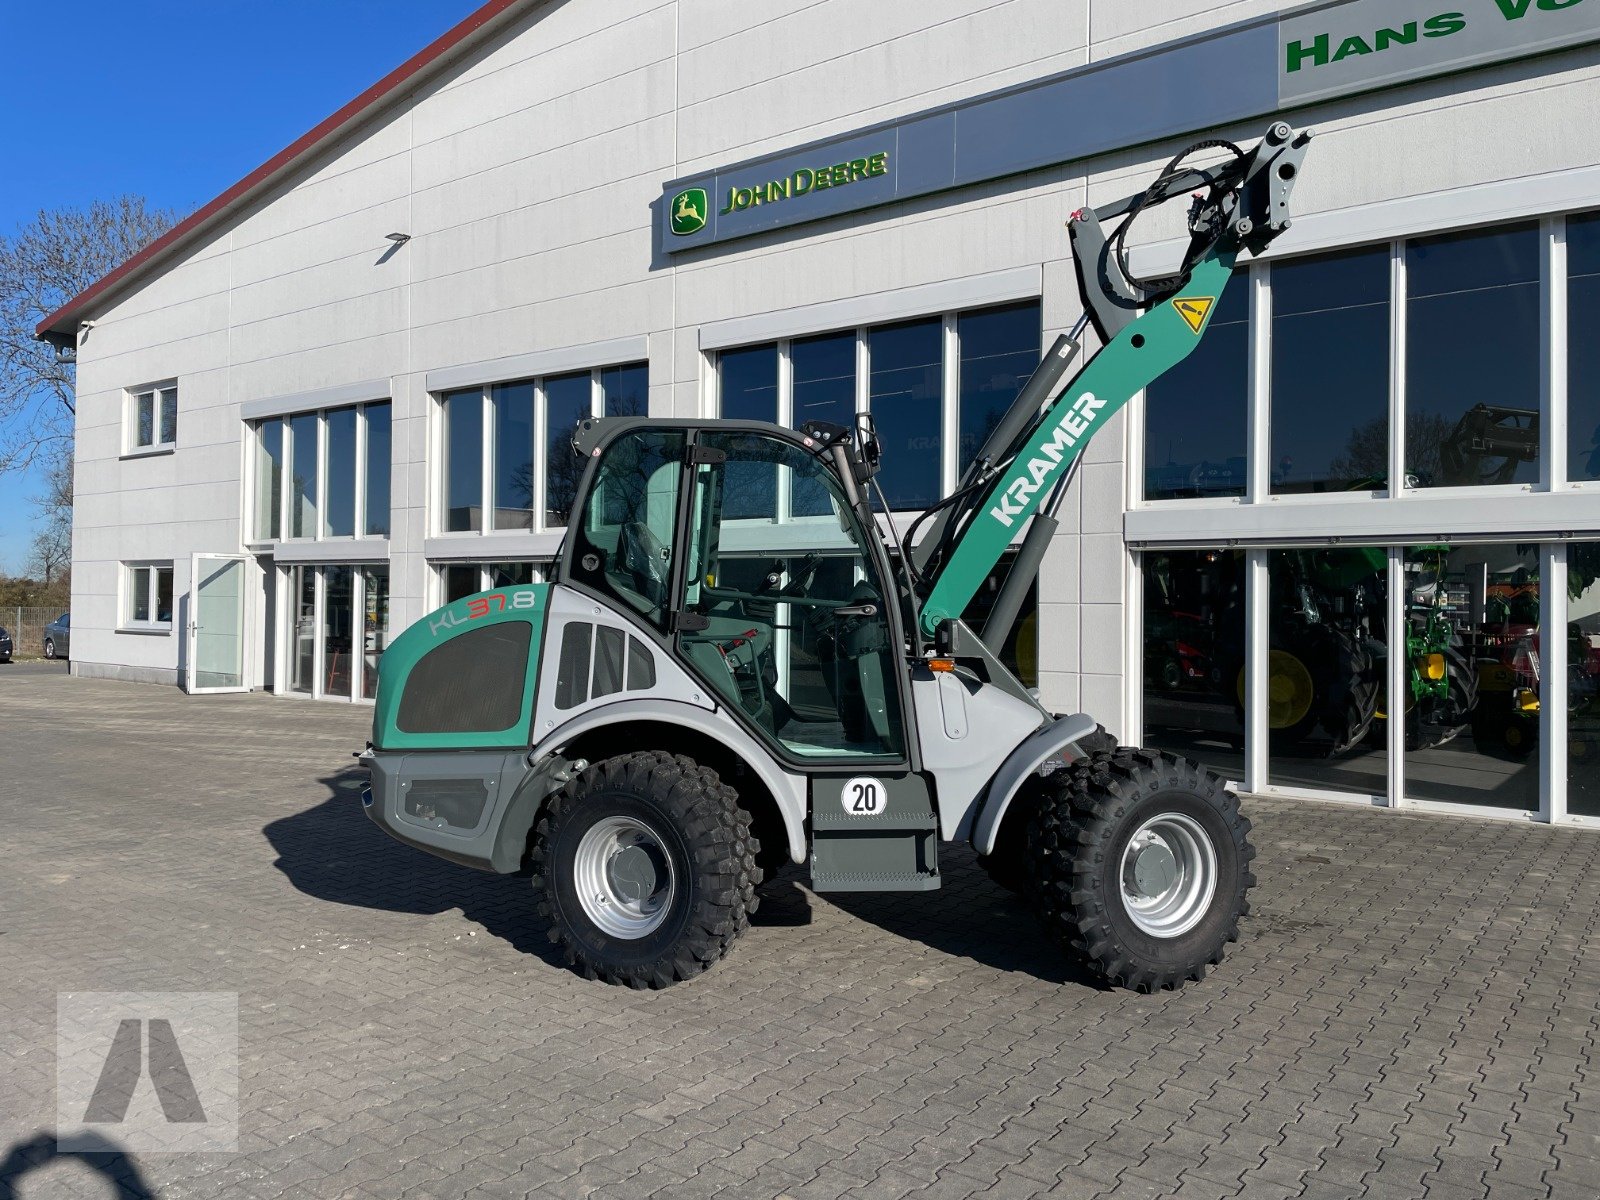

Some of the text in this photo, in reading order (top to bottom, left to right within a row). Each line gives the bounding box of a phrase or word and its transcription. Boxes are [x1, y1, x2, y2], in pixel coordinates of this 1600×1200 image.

[1286, 12, 1467, 73] HANS
[720, 152, 889, 216] JOHN DEERE
[907, 432, 976, 450] KRAR
[990, 391, 1108, 528] KRAMER
[428, 590, 536, 637] KL37.8
[852, 783, 876, 811] 20
